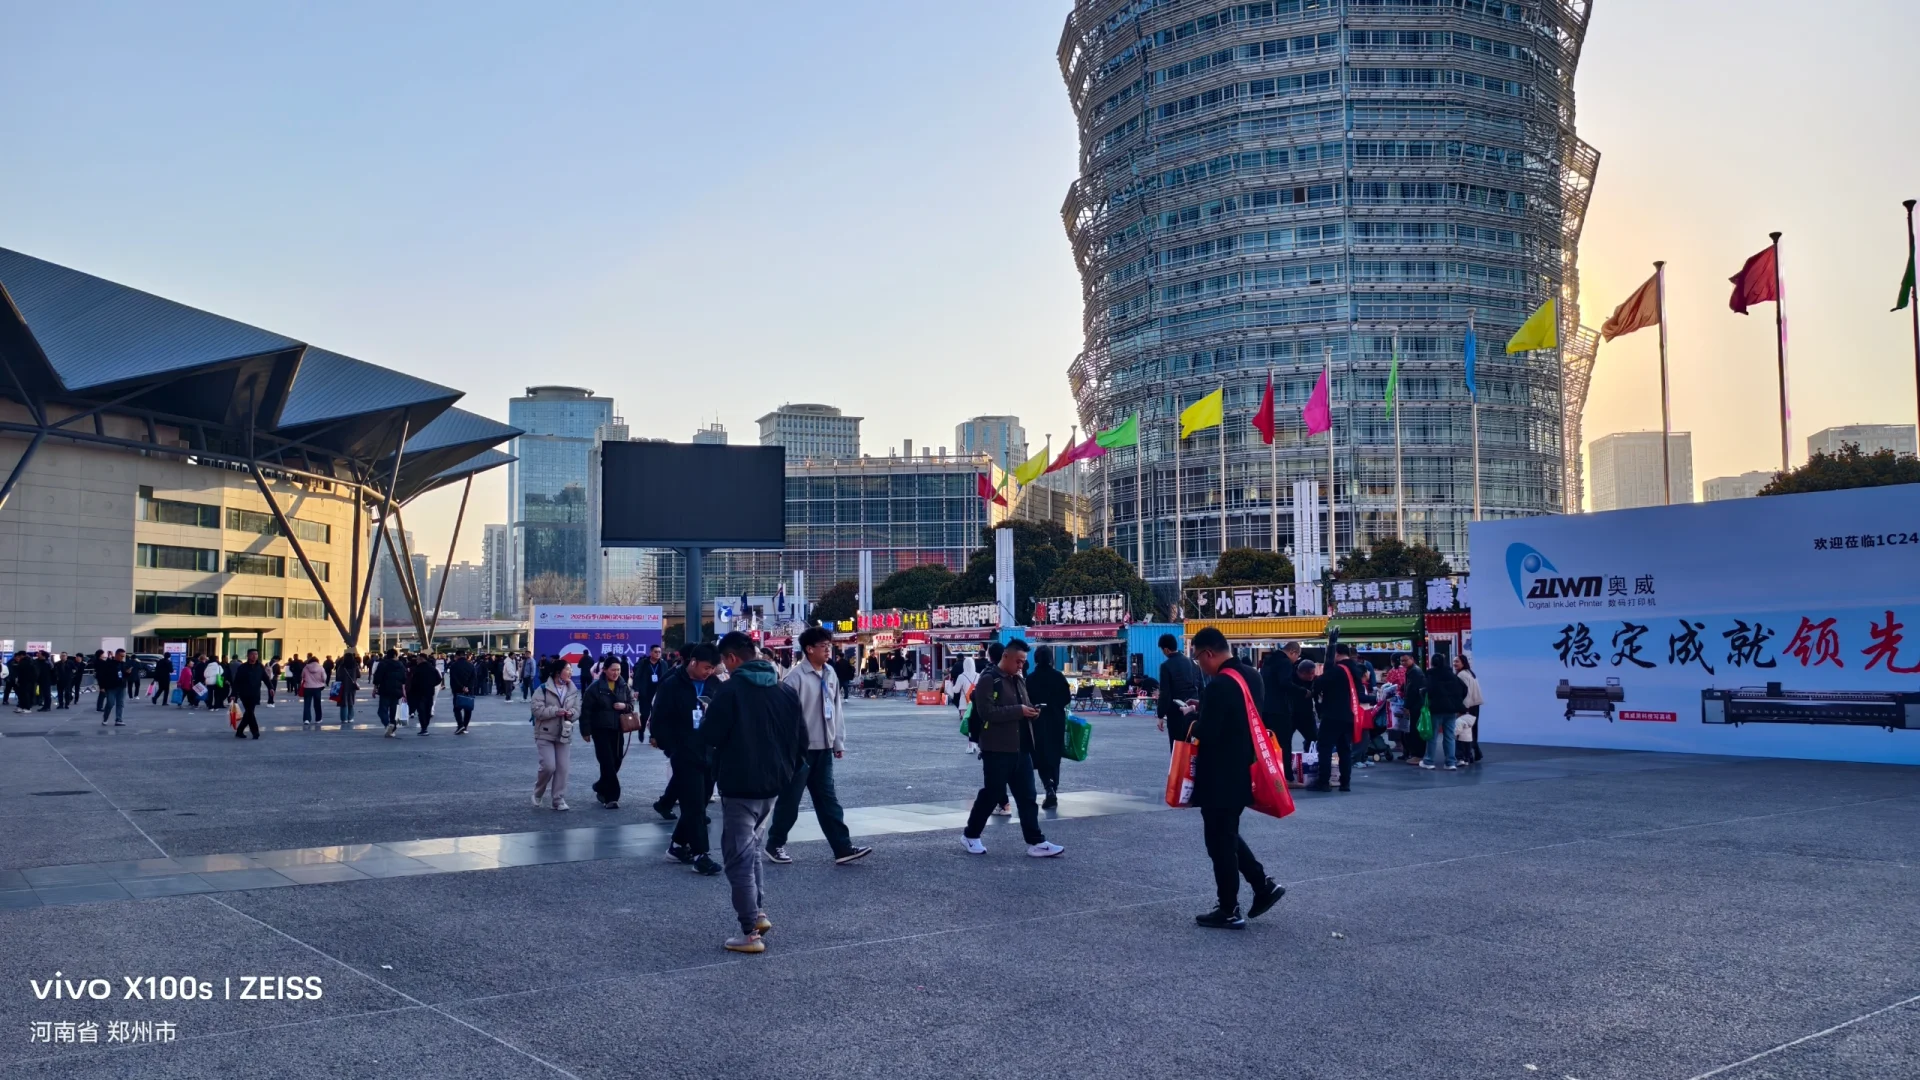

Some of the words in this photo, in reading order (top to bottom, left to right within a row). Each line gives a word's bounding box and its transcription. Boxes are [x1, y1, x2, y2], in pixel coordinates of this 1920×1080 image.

[1333, 580, 1413, 601] 香菇鸡丁面
[1608, 574, 1655, 596] 奥威
[1528, 600, 1551, 611] Digital
[1579, 600, 1603, 608] Printer
[1608, 598, 1656, 608] 数码打印机
[601, 643, 647, 655] 展商入口
[1552, 611, 1920, 676] 稳定成就领先
